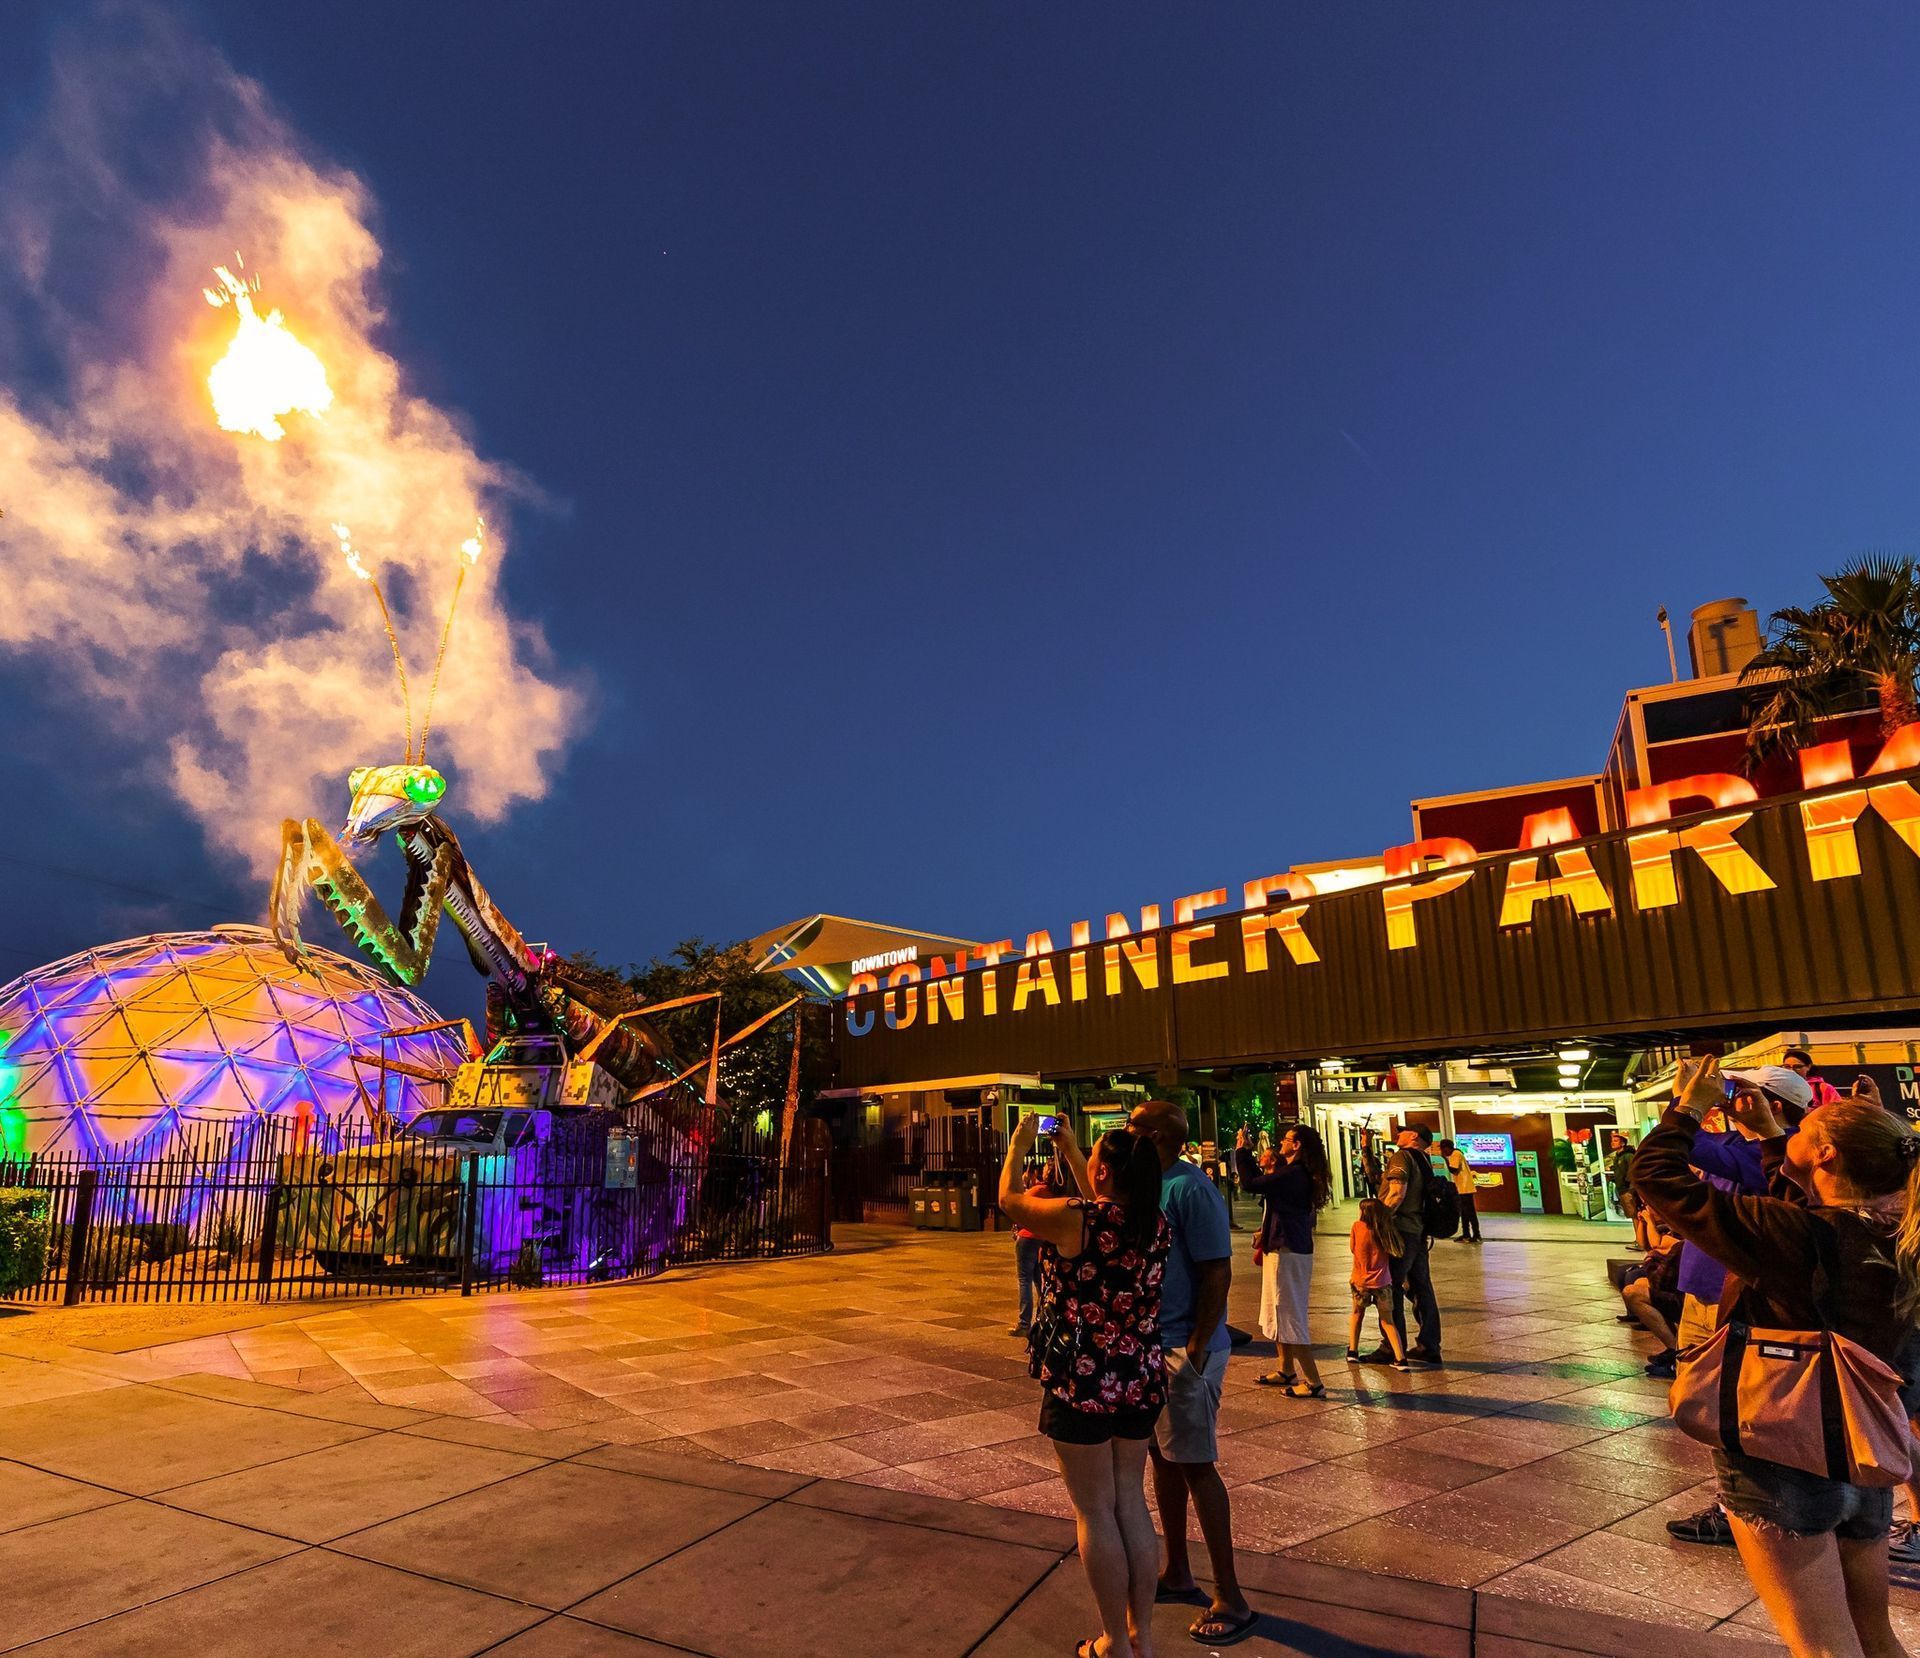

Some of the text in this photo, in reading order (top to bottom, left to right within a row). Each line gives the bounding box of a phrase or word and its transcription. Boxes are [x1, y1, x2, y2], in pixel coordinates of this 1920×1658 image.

[846, 722, 1920, 1037] CONTAINER PARK
[851, 945, 918, 975] DOWNTOWN
